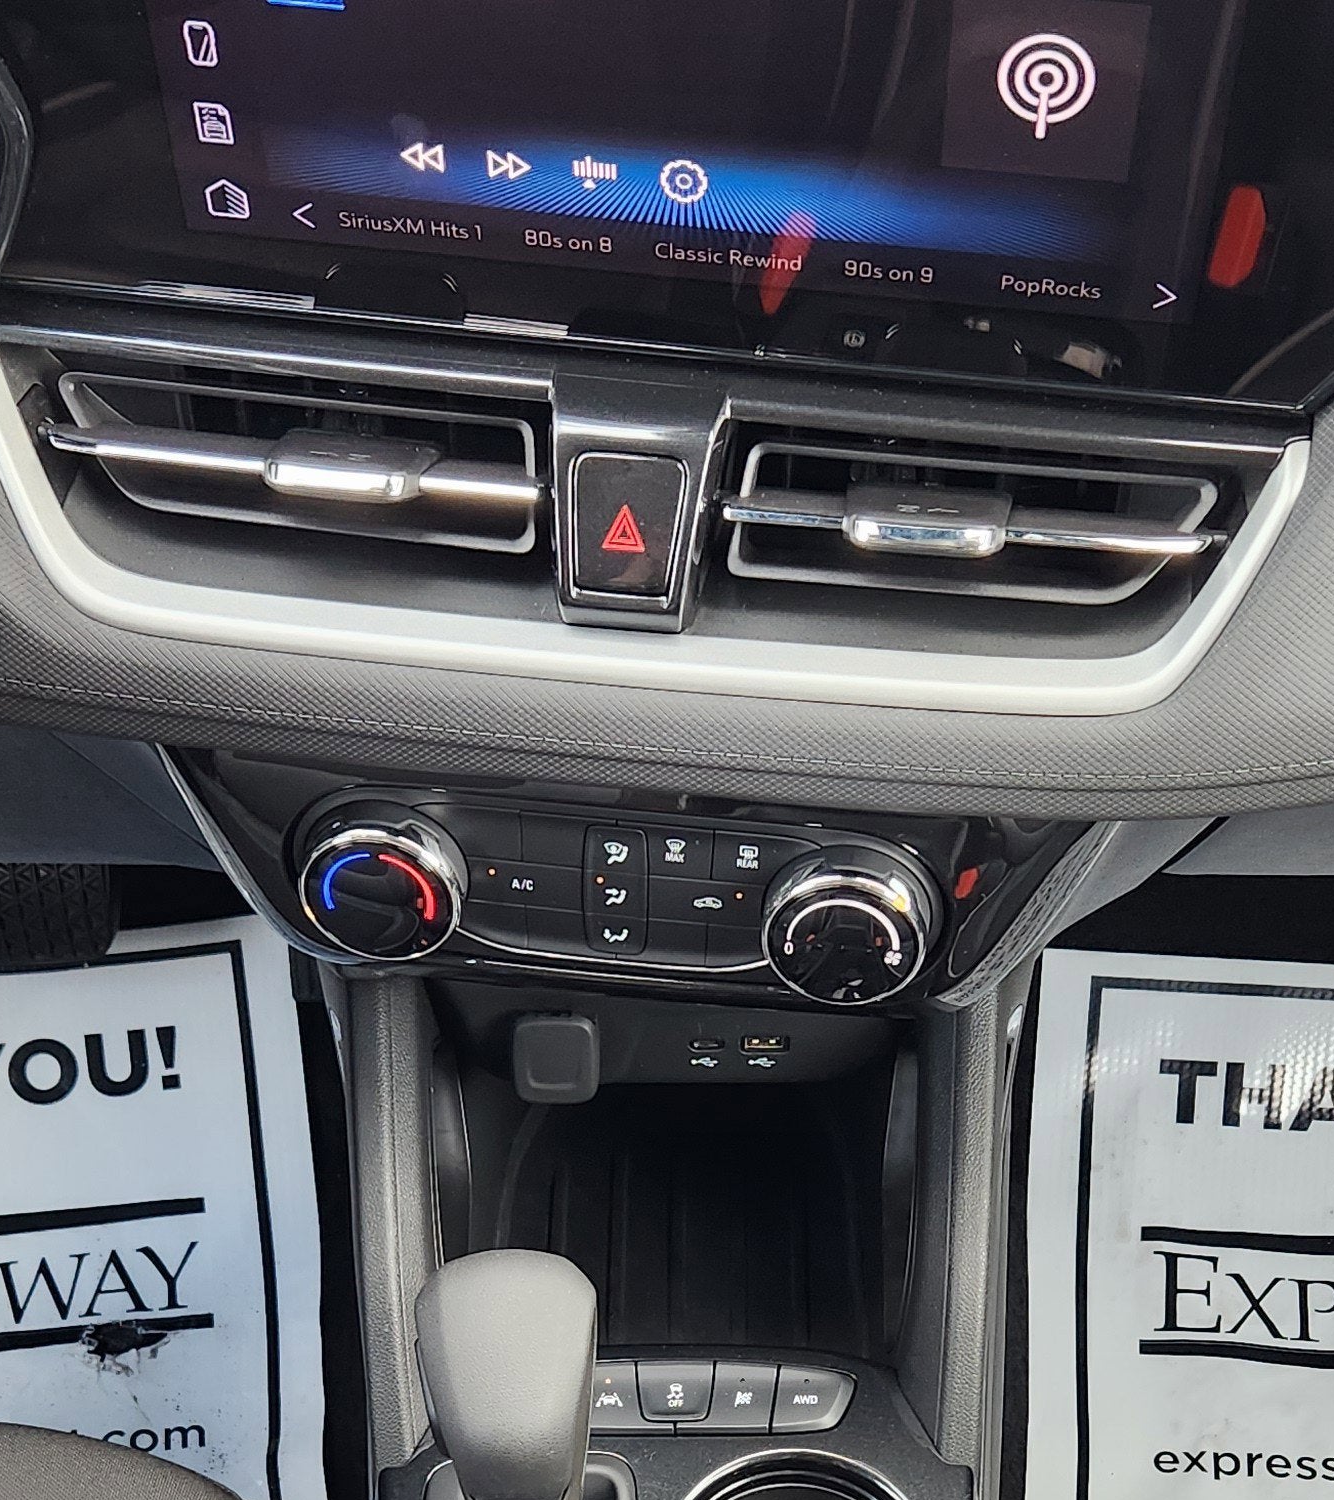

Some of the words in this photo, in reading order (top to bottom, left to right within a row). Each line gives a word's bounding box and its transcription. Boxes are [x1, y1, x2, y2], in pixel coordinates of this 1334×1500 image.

[338, 211, 425, 236] SiriusXM
[430, 221, 469, 240] Hits
[474, 225, 482, 241] 1
[525, 229, 563, 249] 80s
[568, 237, 593, 252] on
[599, 236, 613, 253] 8
[654, 242, 723, 266] Classic
[729, 248, 803, 273] Rewind
[844, 260, 883, 280] 90s
[888, 266, 915, 283] on
[920, 266, 934, 284] 9
[1000, 274, 1102, 301] PopRocks
[664, 852, 685, 863] MAX
[736, 858, 759, 869] REAR
[511, 878, 534, 891] A/C
[667, 1399, 684, 1408] OFF
[792, 1394, 819, 1405] AWD
